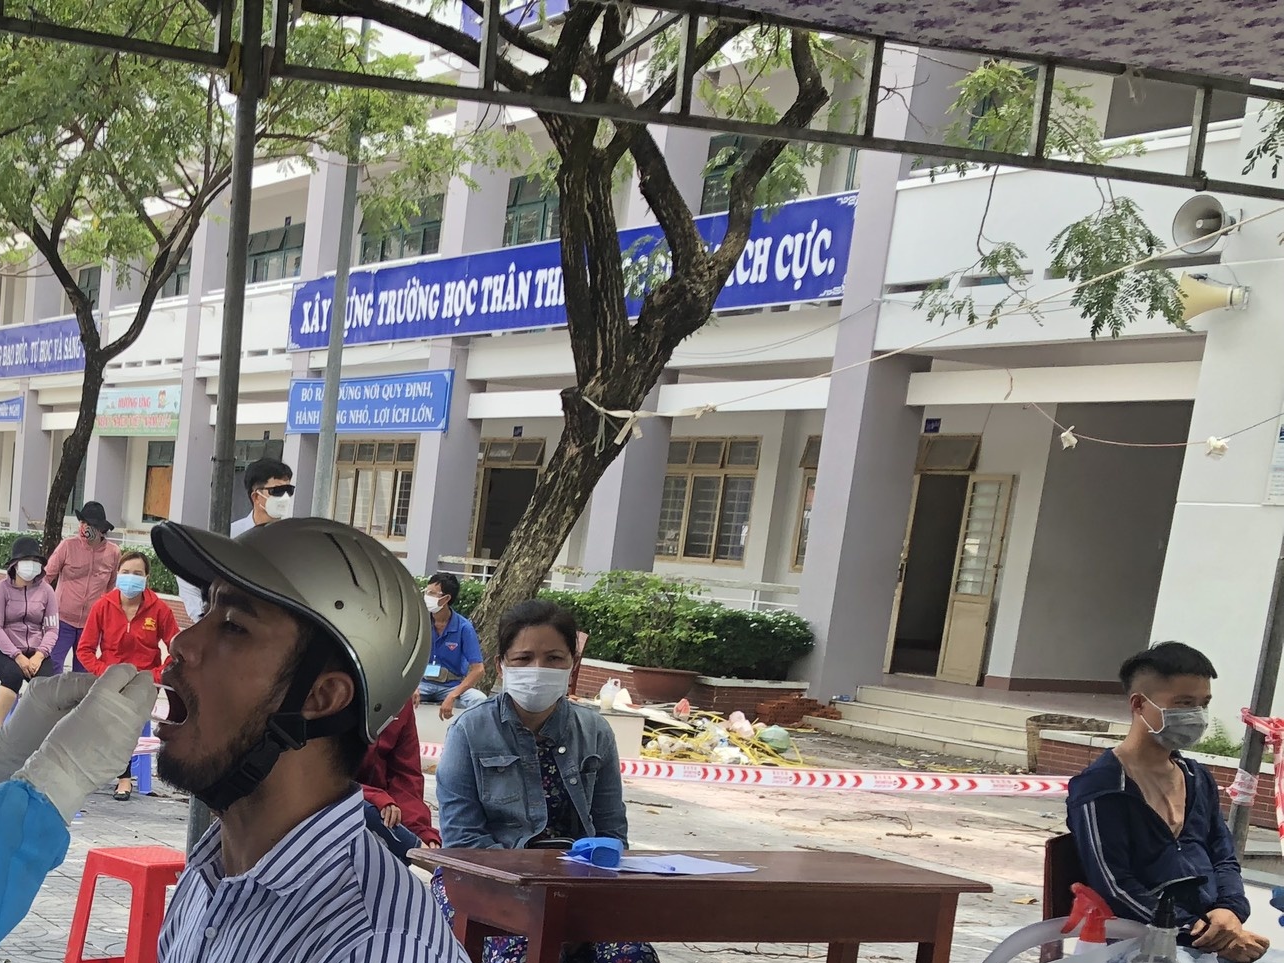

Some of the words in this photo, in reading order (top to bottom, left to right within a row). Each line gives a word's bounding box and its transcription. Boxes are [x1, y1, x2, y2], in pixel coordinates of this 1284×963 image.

[300, 292, 332, 335] XÂY
[342, 286, 374, 338] ỰNG
[376, 275, 441, 326] TRƯỜNG
[441, 278, 478, 327] HỌC
[480, 261, 533, 314] THÂN
[774, 218, 835, 292] CỰC.
[315, 383, 325, 400] RÁ
[363, 383, 380, 400] NƠI
[382, 382, 404, 401] QUY
[405, 381, 434, 401] ĐỊNH,
[295, 407, 320, 425] HÀNH
[349, 404, 372, 426] NHỎ,
[373, 404, 390, 427] LỢI
[391, 404, 410, 423] ÍCH
[411, 402, 436, 423] LỚN.
